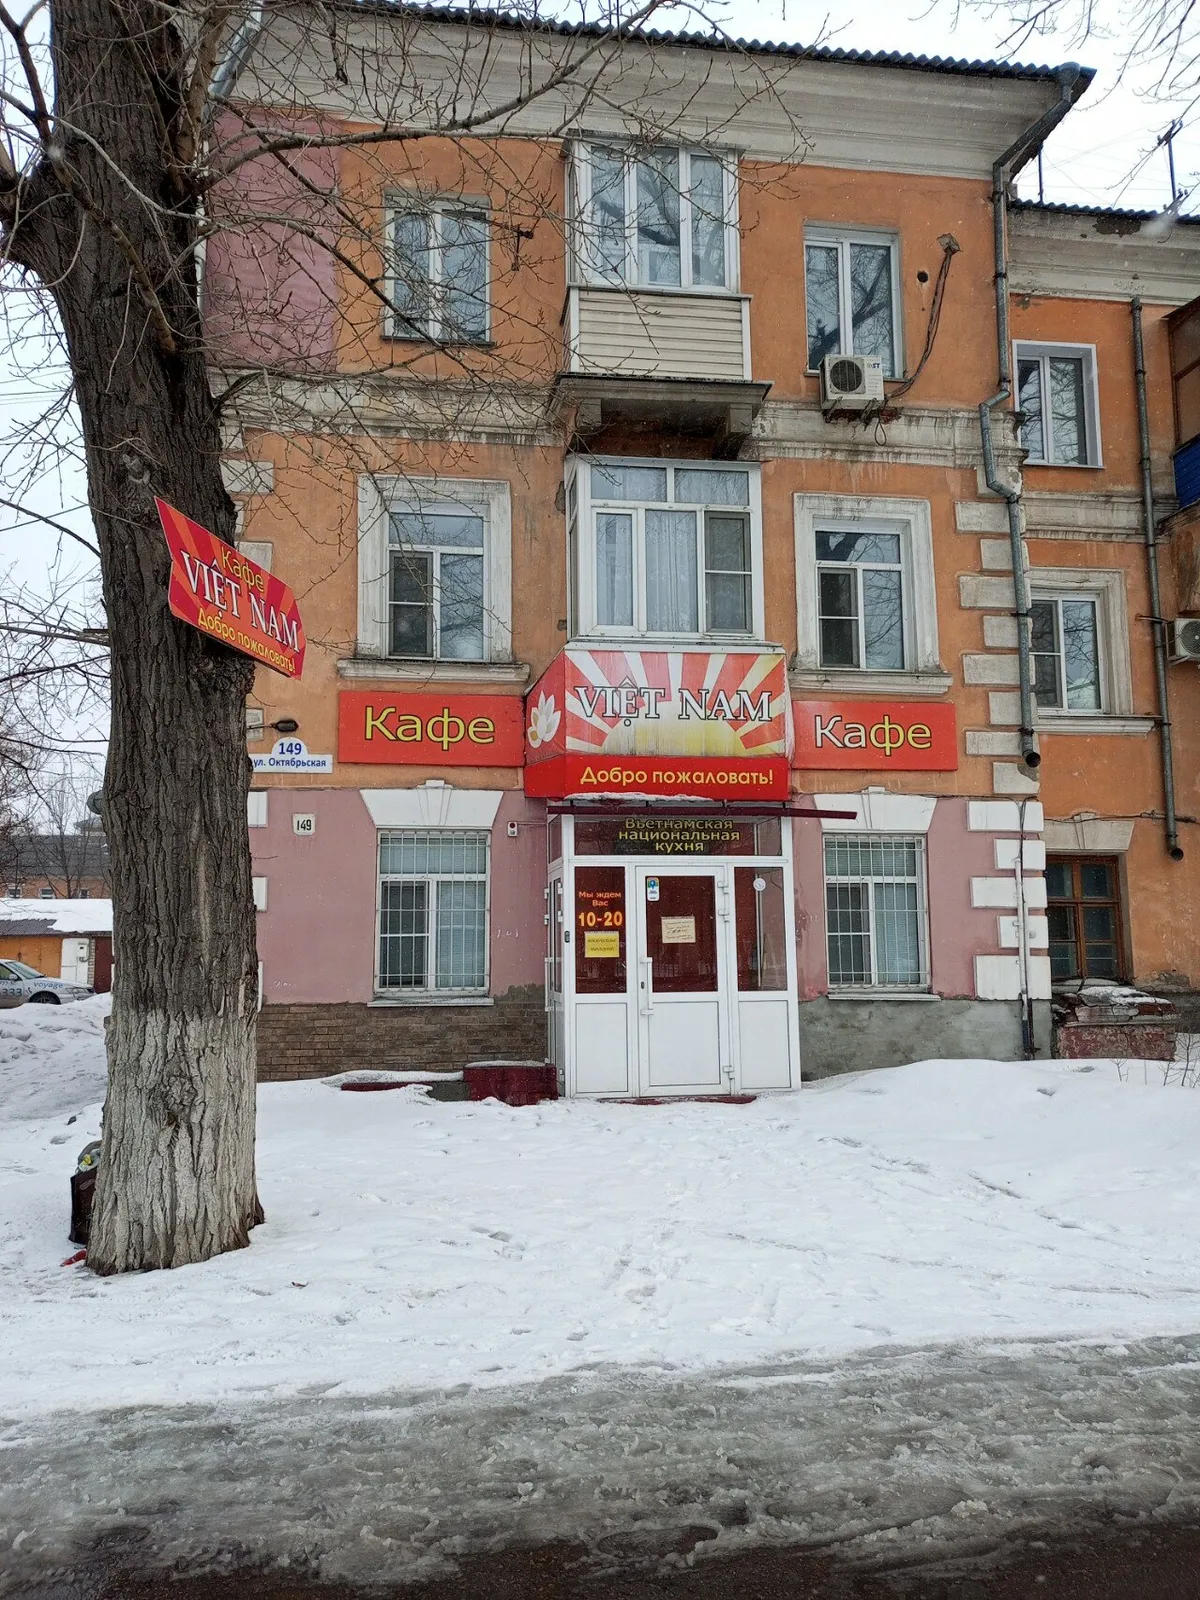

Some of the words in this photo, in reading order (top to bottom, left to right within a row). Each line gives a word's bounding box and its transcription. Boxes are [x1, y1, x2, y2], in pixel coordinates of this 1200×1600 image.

[221, 546, 265, 592] Кафе
[180, 550, 241, 618] VIỆT
[249, 592, 300, 653] NAM
[198, 608, 236, 641] Добро
[237, 631, 296, 673] пожаловать!
[574, 675, 665, 727] VIỆT
[678, 688, 772, 722] NAM
[364, 705, 495, 751] Кафе
[814, 714, 932, 757] Кафе
[278, 742, 302, 755] 149
[253, 759, 266, 768] ул.
[268, 757, 326, 768] Октябрьская
[580, 767, 647, 787] Добро
[652, 769, 774, 785] пожаловать!
[297, 819, 312, 831] 149
[625, 817, 733, 830] Вьетнамская
[619, 831, 740, 842] национальная
[655, 842, 704, 853] кухня
[596, 891, 622, 899] ждем
[578, 911, 623, 927] 10-20
[33, 981, 64, 990] voyage
